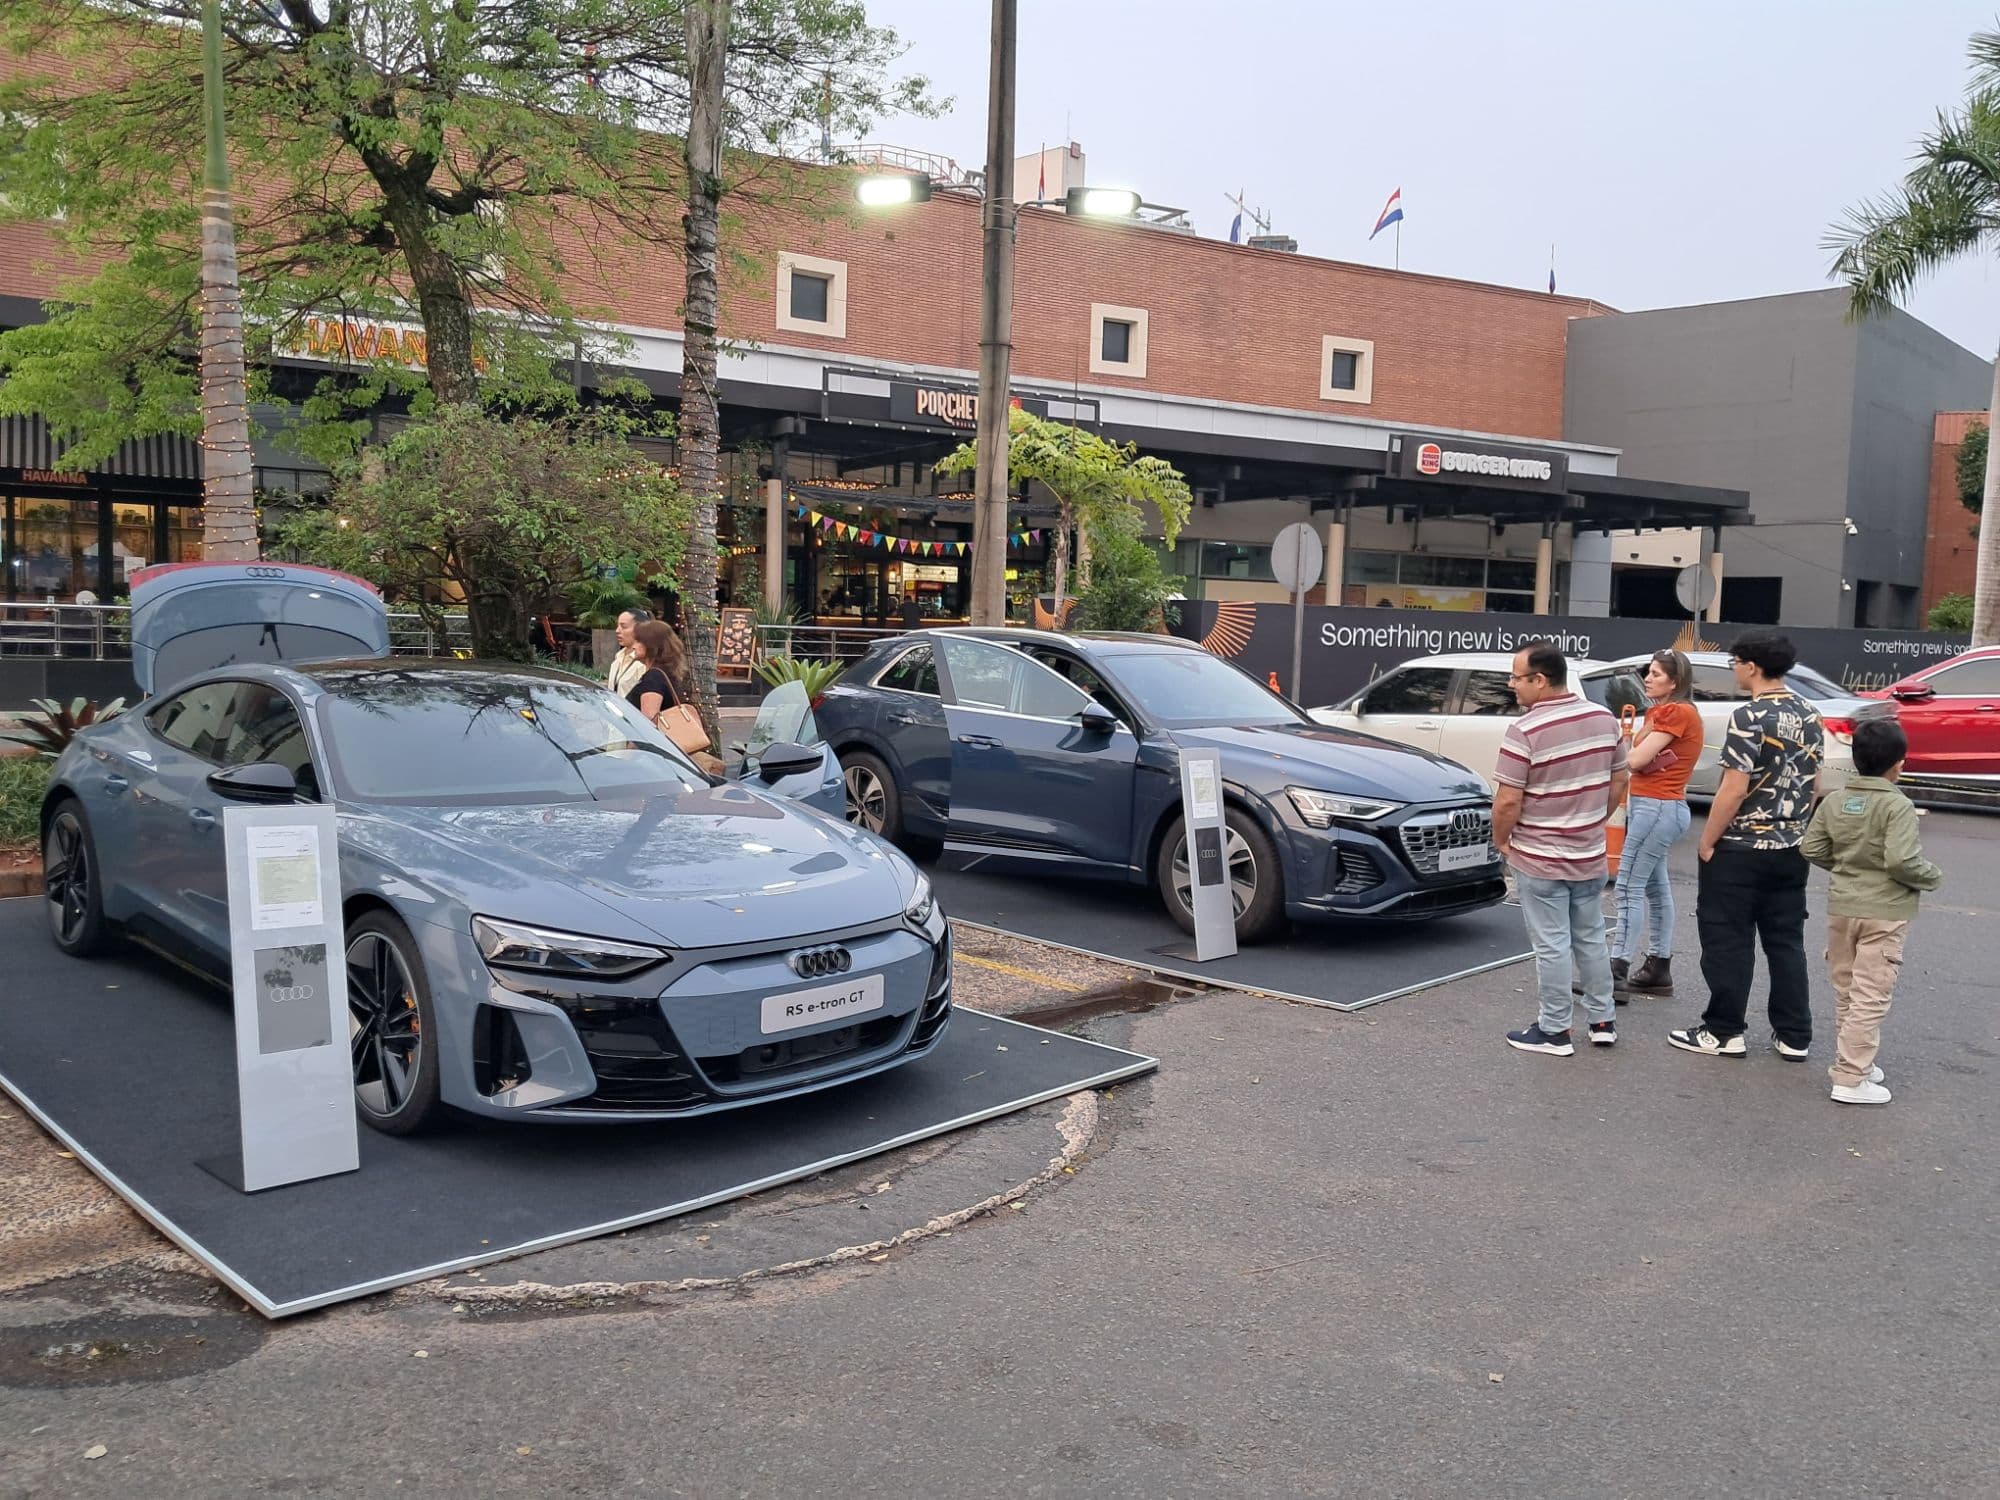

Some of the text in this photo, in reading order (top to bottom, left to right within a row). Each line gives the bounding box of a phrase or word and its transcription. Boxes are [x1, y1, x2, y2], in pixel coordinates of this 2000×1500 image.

[23, 470, 88, 484] HAVANNA
[1442, 451, 1551, 481] BURGER KING
[1320, 623, 1443, 654] Something
[1449, 629, 1493, 651] new
[1497, 627, 1514, 651] is
[1863, 639, 1919, 657] Something
[1921, 644, 1943, 655] new
[1944, 641, 1953, 656] is
[786, 990, 865, 1017] RS e-tron GT
